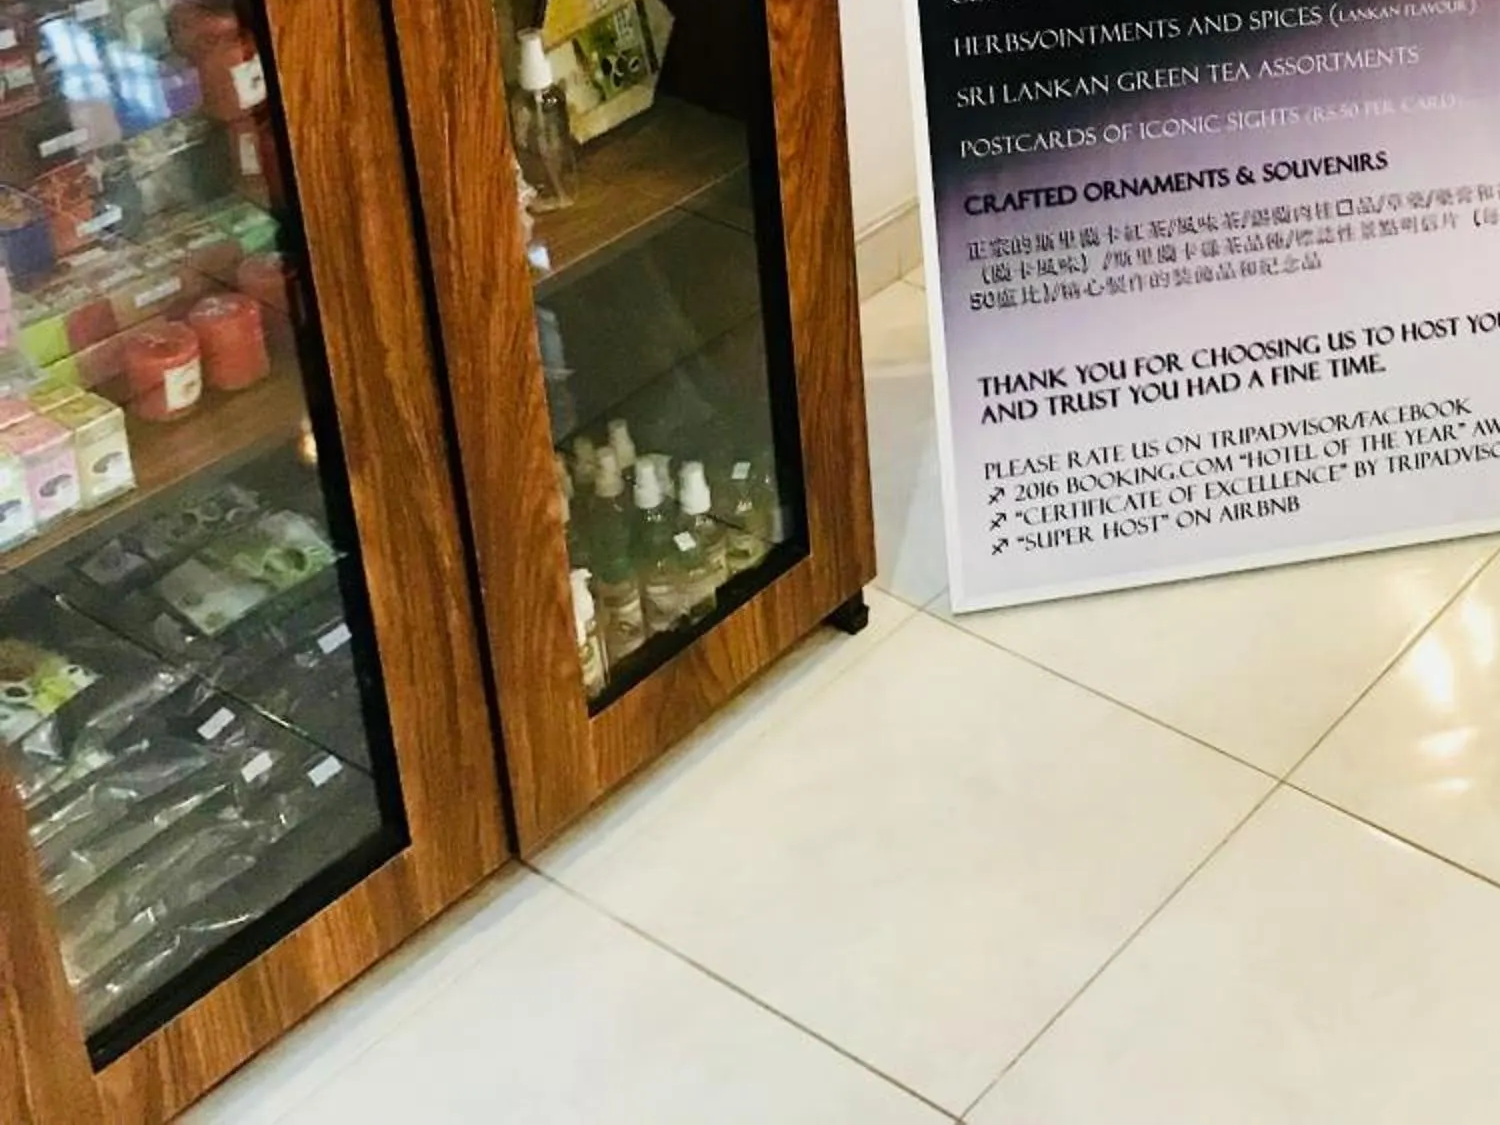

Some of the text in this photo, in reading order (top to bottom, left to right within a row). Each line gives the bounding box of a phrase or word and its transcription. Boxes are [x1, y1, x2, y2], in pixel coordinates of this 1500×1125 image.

[1186, 12, 1242, 37] AND
[1248, 6, 1323, 31] SPICES
[1328, 0, 1401, 24] (LANKAN
[956, 46, 1420, 107] SRI LANKAN GREEN TEA ASSORTMENTS
[959, 126, 1097, 158] POSTCARDS
[1102, 122, 1133, 144] OF
[1138, 114, 1221, 141] ICONIC
[1227, 106, 1301, 132] SIGHTS
[963, 151, 1388, 215] CRAFTED ORNAMENTS & SOUVENIRS
[978, 366, 1067, 398] THANK
[1077, 359, 1126, 385] YOU
[1133, 351, 1184, 378] FOR
[1191, 335, 1321, 371] CHOOSING
[1326, 330, 1357, 354] US
[1362, 326, 1395, 349] TO
[1400, 318, 1460, 345] HOST
[980, 396, 1038, 424] AND
[1045, 386, 1121, 416] TRUST
[1129, 378, 1180, 405] YOU
[1186, 371, 1241, 398] HAD
[1247, 368, 1264, 390] A
[1270, 360, 1322, 387] FINE
[984, 397, 1472, 481] PLEASE RATE US ON TRIPADVISOR/FACEBOOK
[1013, 476, 1059, 502] 2016
[1065, 453, 1233, 495] BOOKING.COM
[1323, 436, 1353, 460] OF
[1358, 430, 1401, 455] THE
[1168, 482, 1199, 506] OF
[1354, 457, 1380, 480] BY
[1175, 506, 1212, 530] ON
[1217, 494, 1301, 524] AIRBNB
